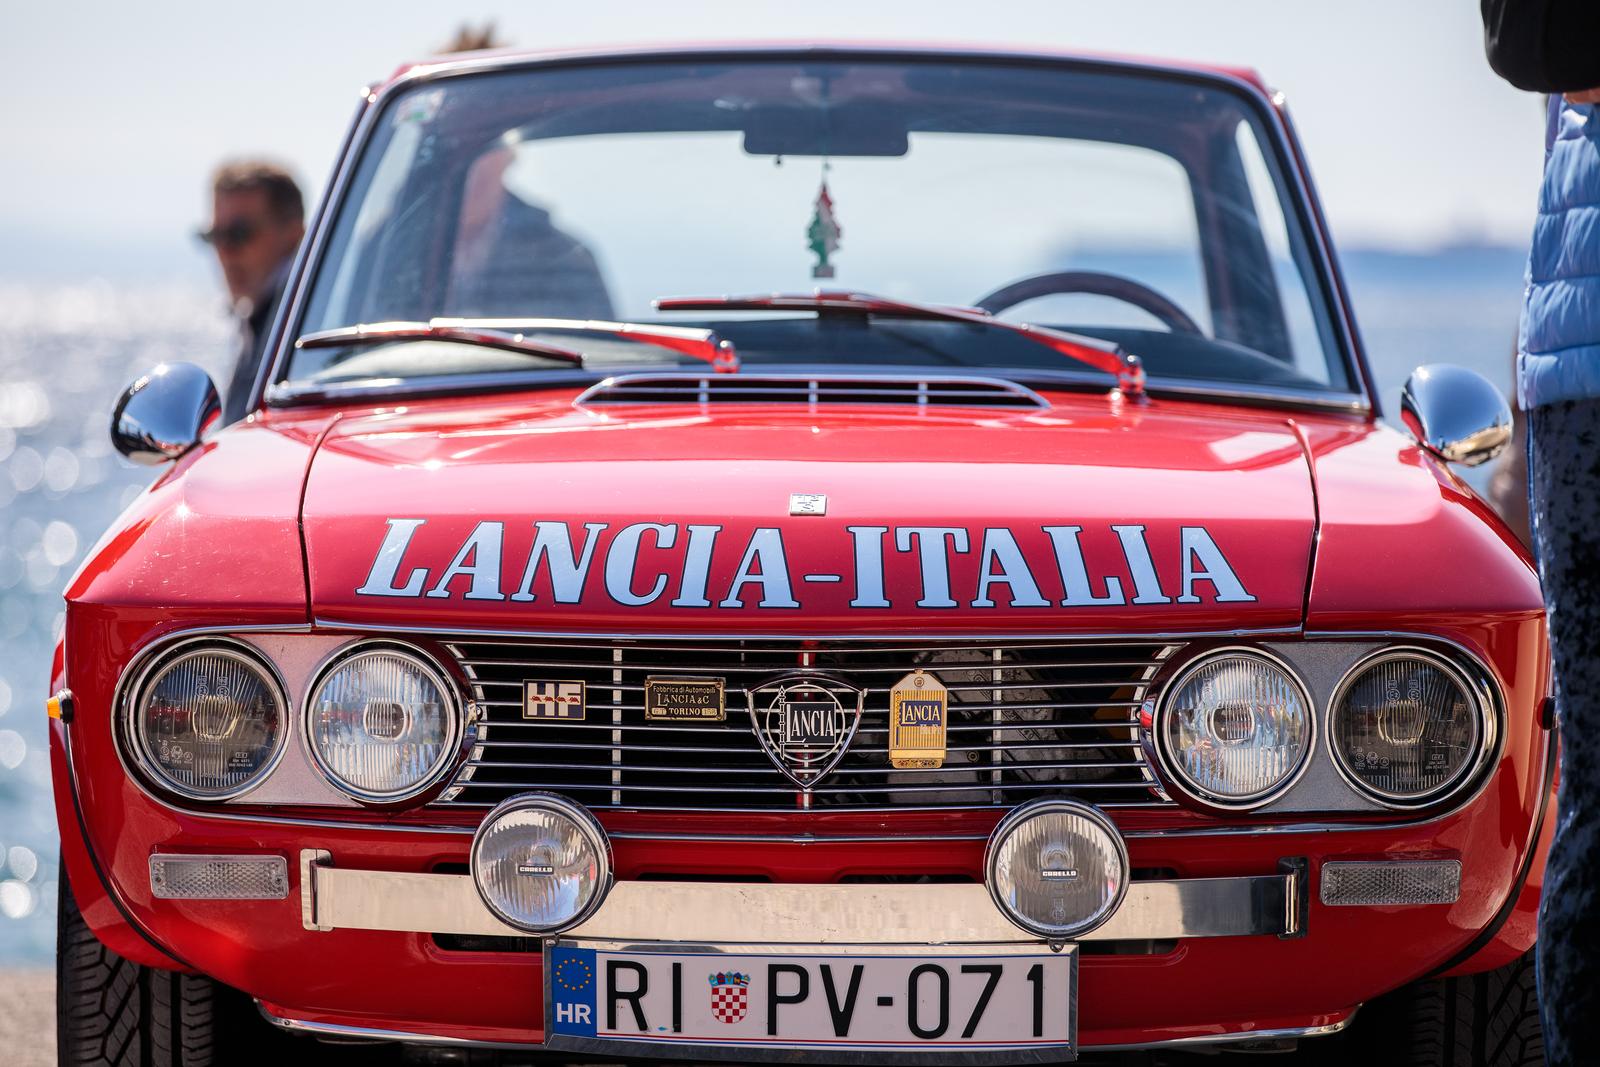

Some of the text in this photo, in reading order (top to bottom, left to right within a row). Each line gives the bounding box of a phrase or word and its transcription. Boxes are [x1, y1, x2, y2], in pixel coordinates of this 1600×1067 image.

[355, 518, 1258, 608] LANCIA-ITALIA
[527, 683, 581, 716] HF
[668, 707, 700, 715] TORINO
[901, 702, 940, 725] LANCIA
[785, 703, 835, 743] LANCIA
[556, 1002, 591, 1024] HR
[607, 960, 1043, 1039] RI PV-071
